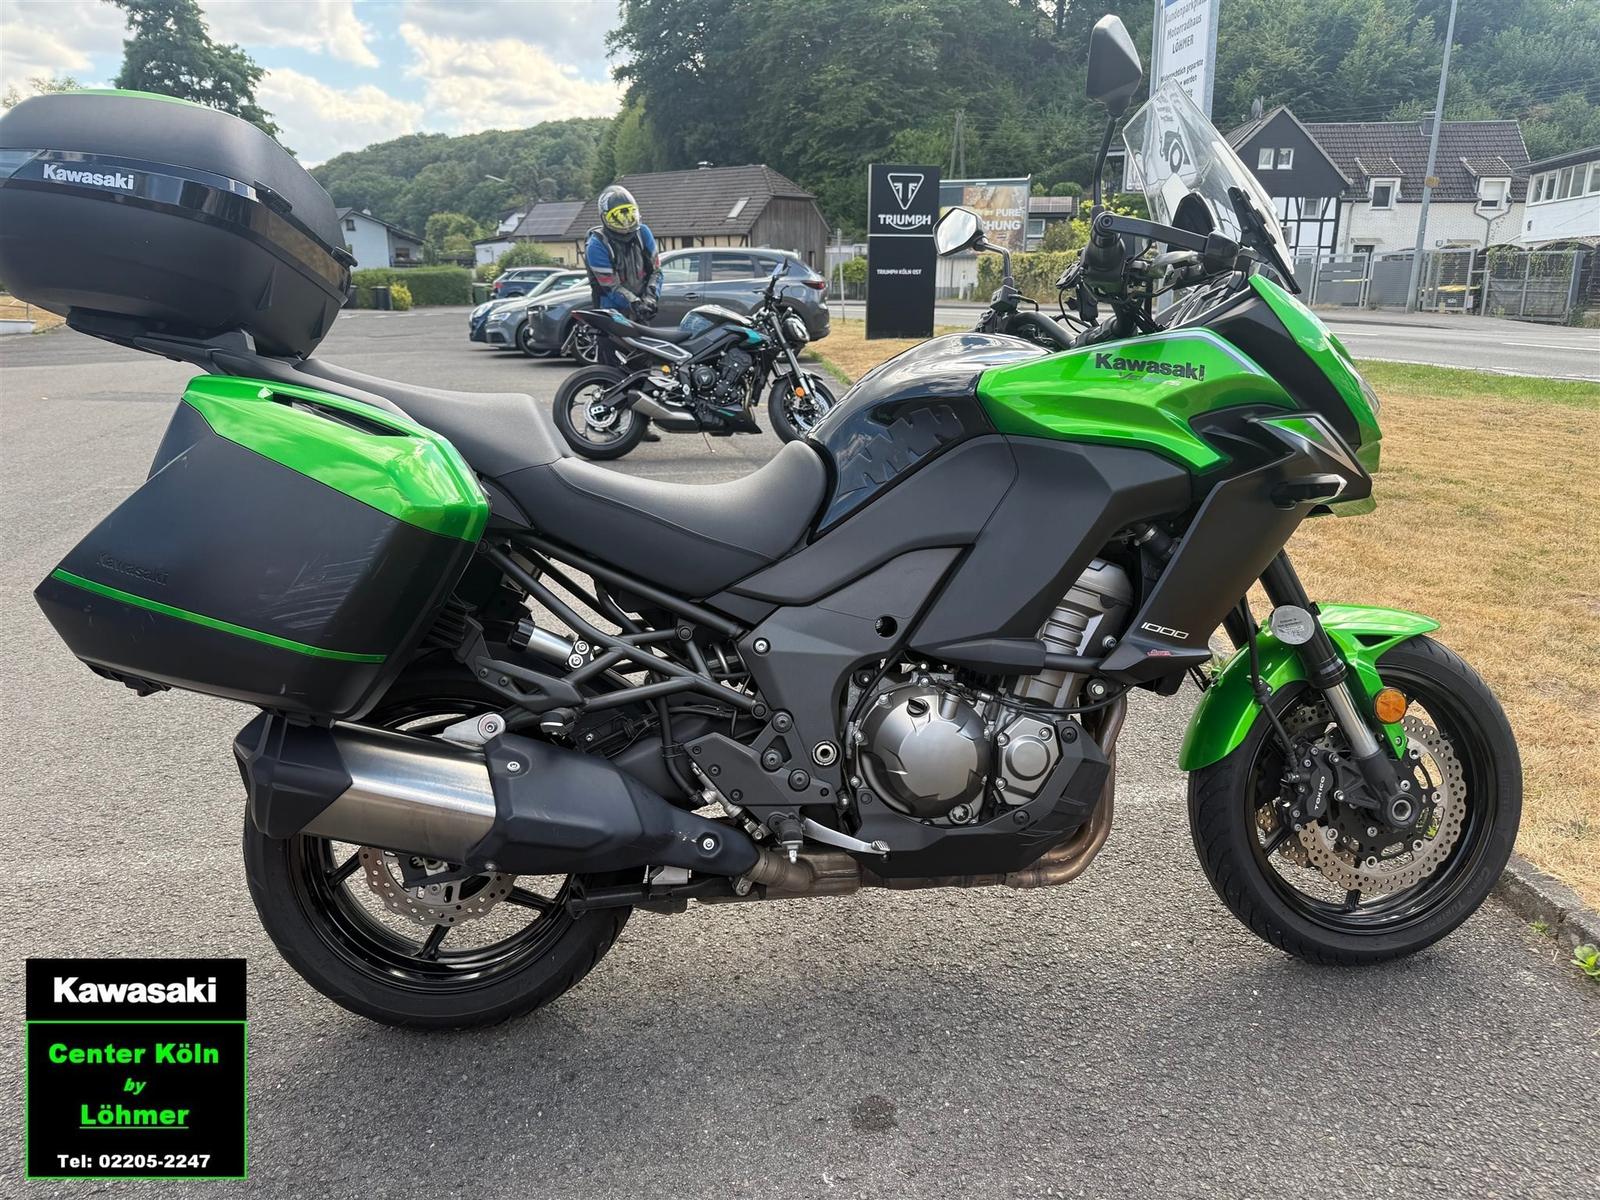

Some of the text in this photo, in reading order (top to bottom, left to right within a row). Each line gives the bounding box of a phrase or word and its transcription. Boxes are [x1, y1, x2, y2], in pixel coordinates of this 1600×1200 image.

[42, 163, 135, 191] Kawasaki
[877, 213, 932, 229] TRIUMPH
[995, 207, 1020, 217] PURE
[898, 267, 912, 275] KÖLN
[1094, 352, 1206, 382] Kawasaki
[1140, 621, 1190, 640] 1000
[1313, 775, 1326, 811] TOKICO
